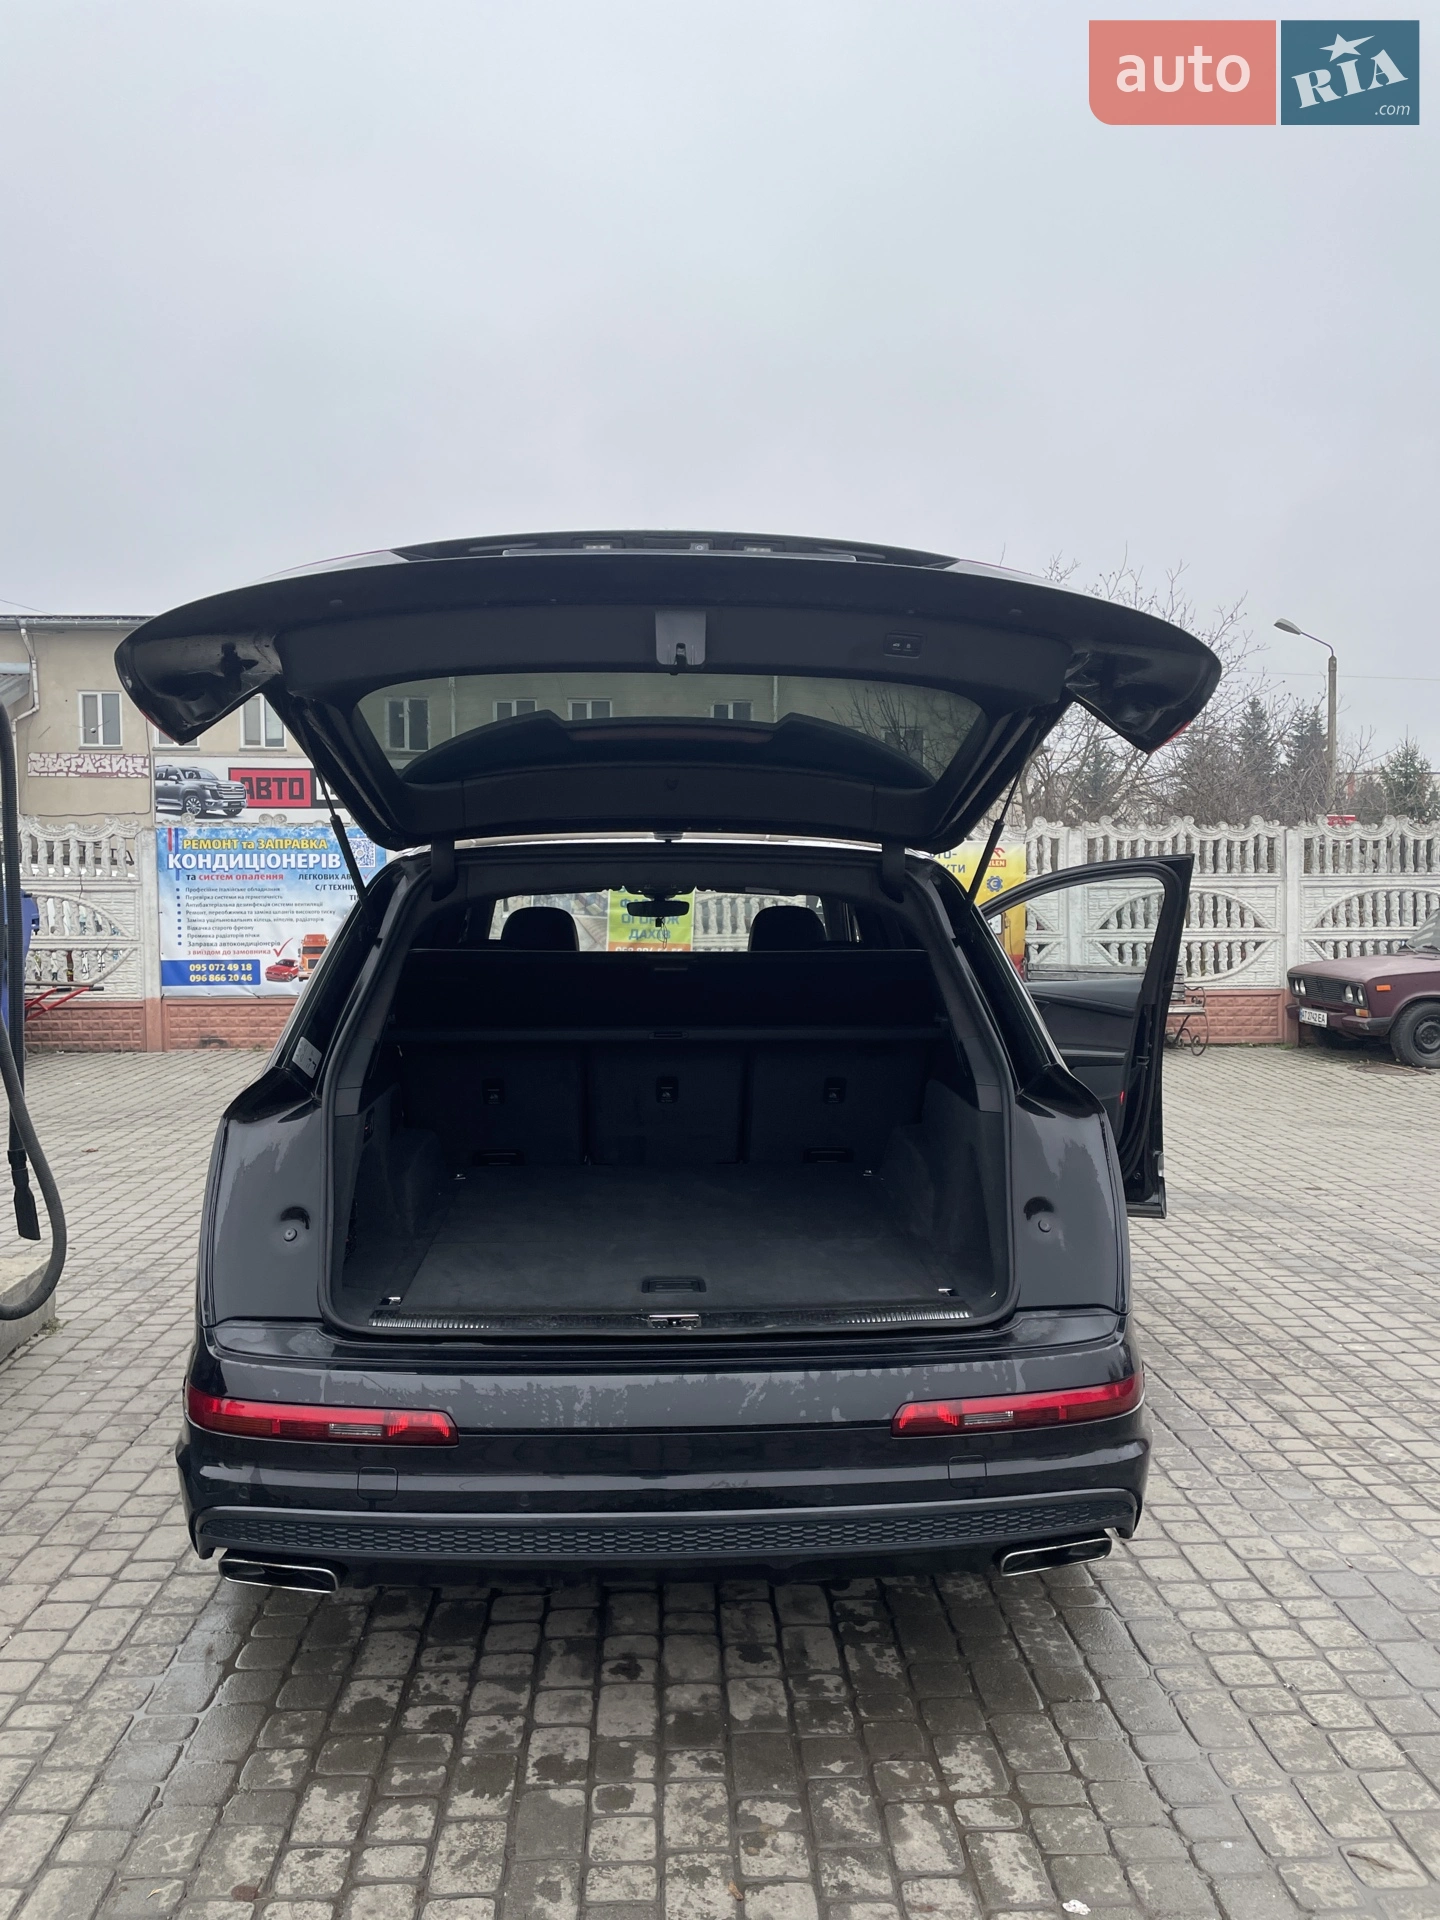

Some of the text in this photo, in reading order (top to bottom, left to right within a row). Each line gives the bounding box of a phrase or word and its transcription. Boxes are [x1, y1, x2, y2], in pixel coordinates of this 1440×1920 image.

[240, 777, 305, 800] АВТО
[183, 839, 328, 850] РЕМОНТ та ЗАПРАВКА
[168, 853, 341, 872] КОНДИЦІОНЕРІВ
[199, 873, 233, 881] систем
[235, 873, 284, 881] опалення
[298, 873, 340, 881] ЛЕГКОВИХ
[329, 883, 356, 891] ТЕХНІК
[189, 963, 252, 972] 095 072 49 18
[189, 973, 253, 982] 096 866 20 46
